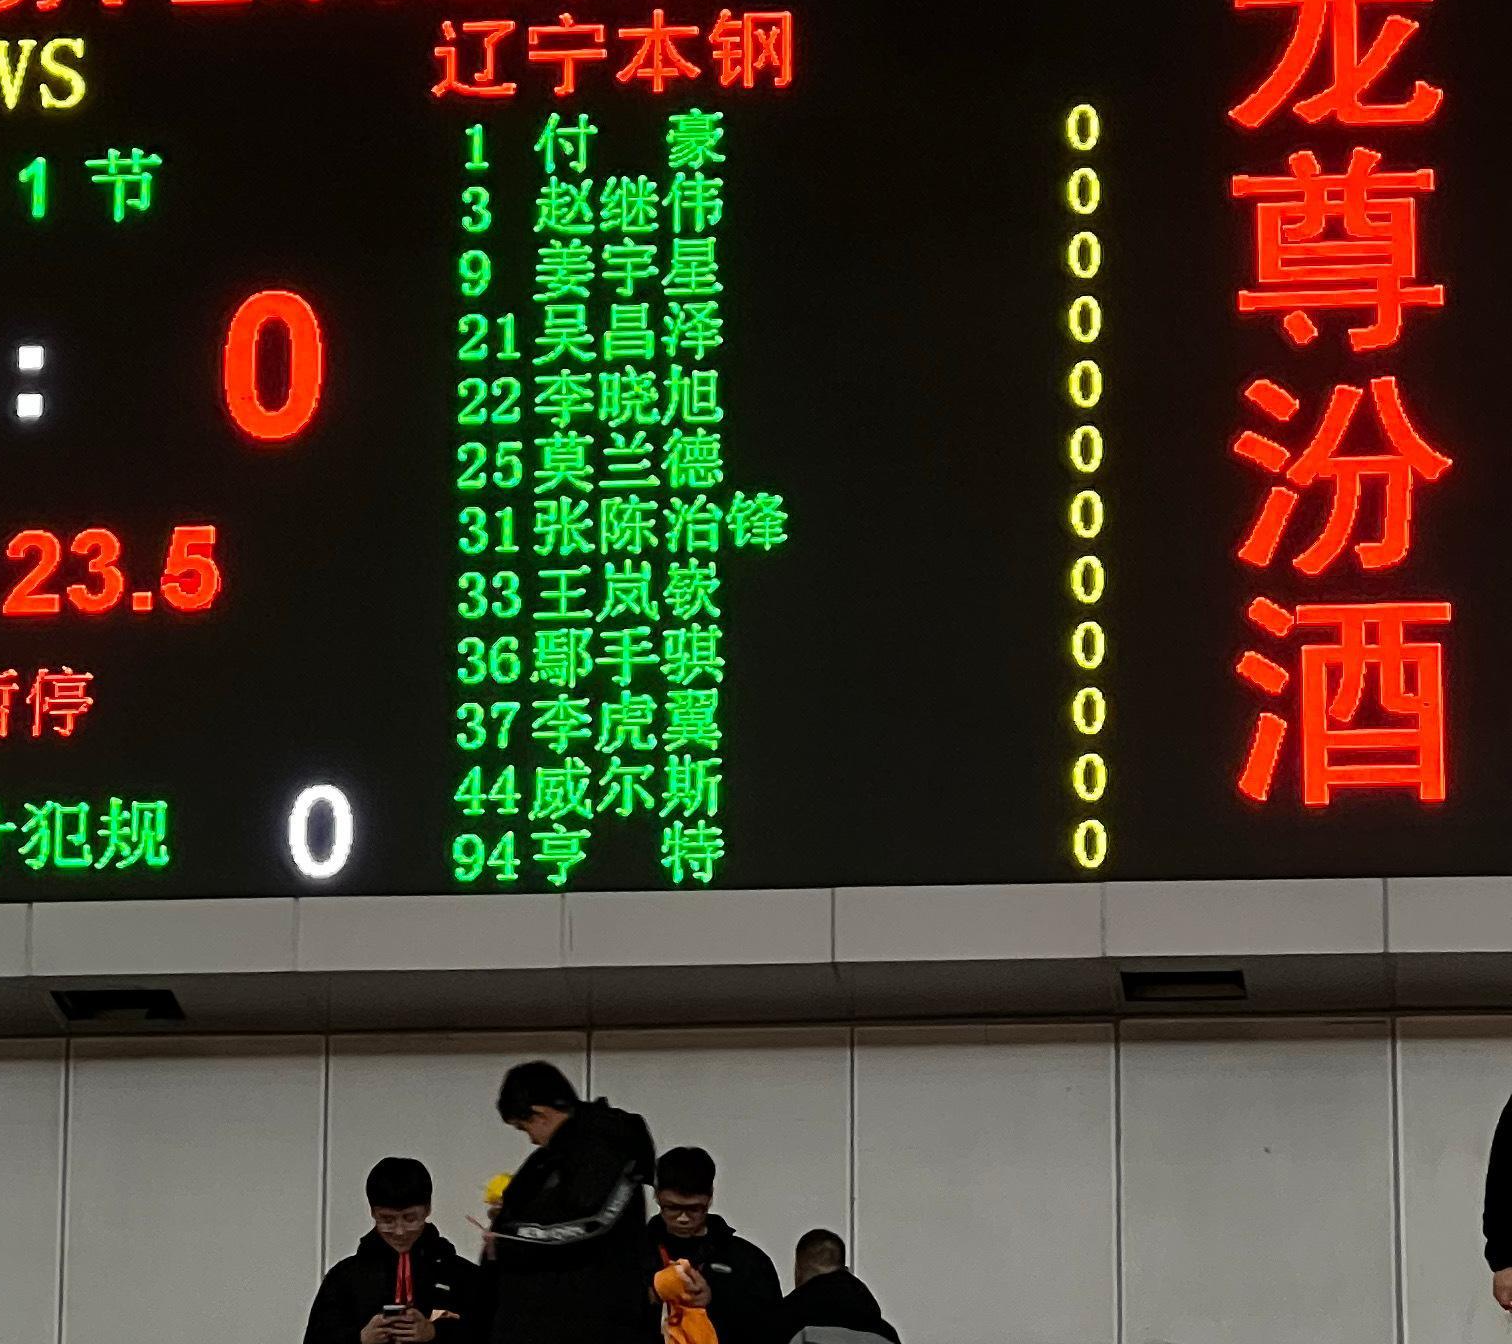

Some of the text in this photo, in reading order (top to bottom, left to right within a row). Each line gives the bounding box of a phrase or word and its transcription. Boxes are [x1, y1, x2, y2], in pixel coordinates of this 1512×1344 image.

[431, 9, 793, 96] 辽宁本钢
[465, 124, 489, 170] 1
[1066, 104, 1099, 150] 0
[462, 168, 1100, 235] 3 赵继伟 0
[459, 232, 1100, 301] 9 姜宇星 0
[459, 298, 1101, 365] 21 吴昌泽 0
[223, 290, 325, 441] 0
[458, 360, 1102, 429] 22 李晓旭 0
[457, 427, 1103, 494] 25 莫兰德 0
[459, 491, 1103, 556] 31 张陈治锋 0
[458, 571, 522, 619] 33
[1071, 557, 1104, 603] 0
[458, 636, 521, 684] 36
[1072, 623, 1104, 669] 0
[457, 688, 1105, 754] 37 李虎翼 0
[454, 754, 1107, 821] 44 威尔斯 0
[288, 785, 353, 878] 0
[452, 831, 520, 881] 94
[1073, 821, 1106, 868] 0
